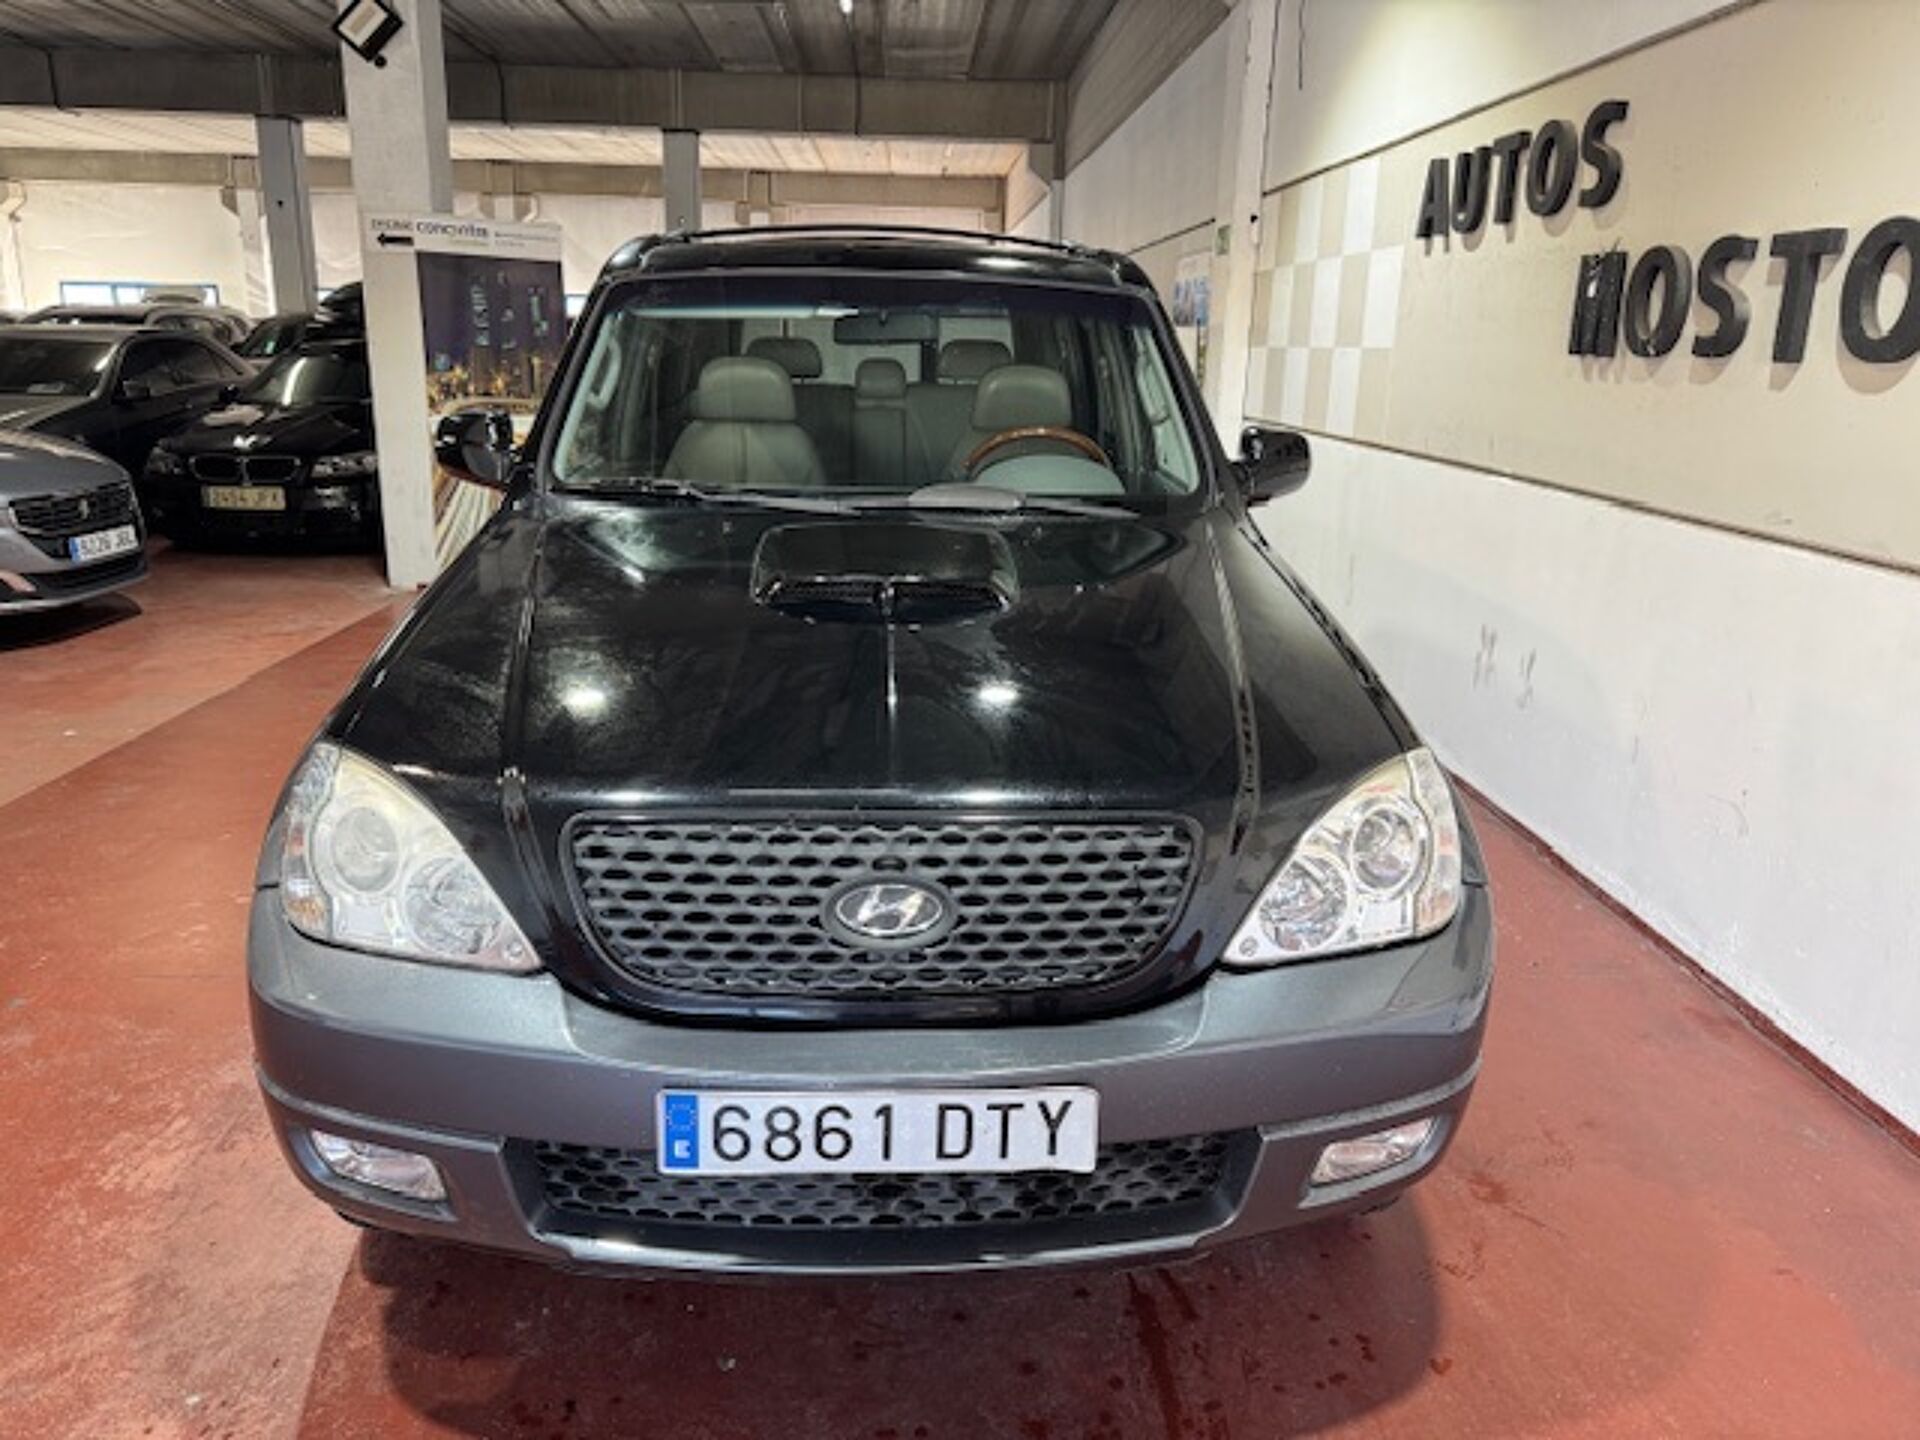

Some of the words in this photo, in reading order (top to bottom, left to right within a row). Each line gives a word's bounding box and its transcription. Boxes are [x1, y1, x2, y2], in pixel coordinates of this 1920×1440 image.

[1416, 100, 1629, 239] AUTOS
[712, 1103, 893, 1163] 6861
[935, 1100, 1074, 1160] DTY
